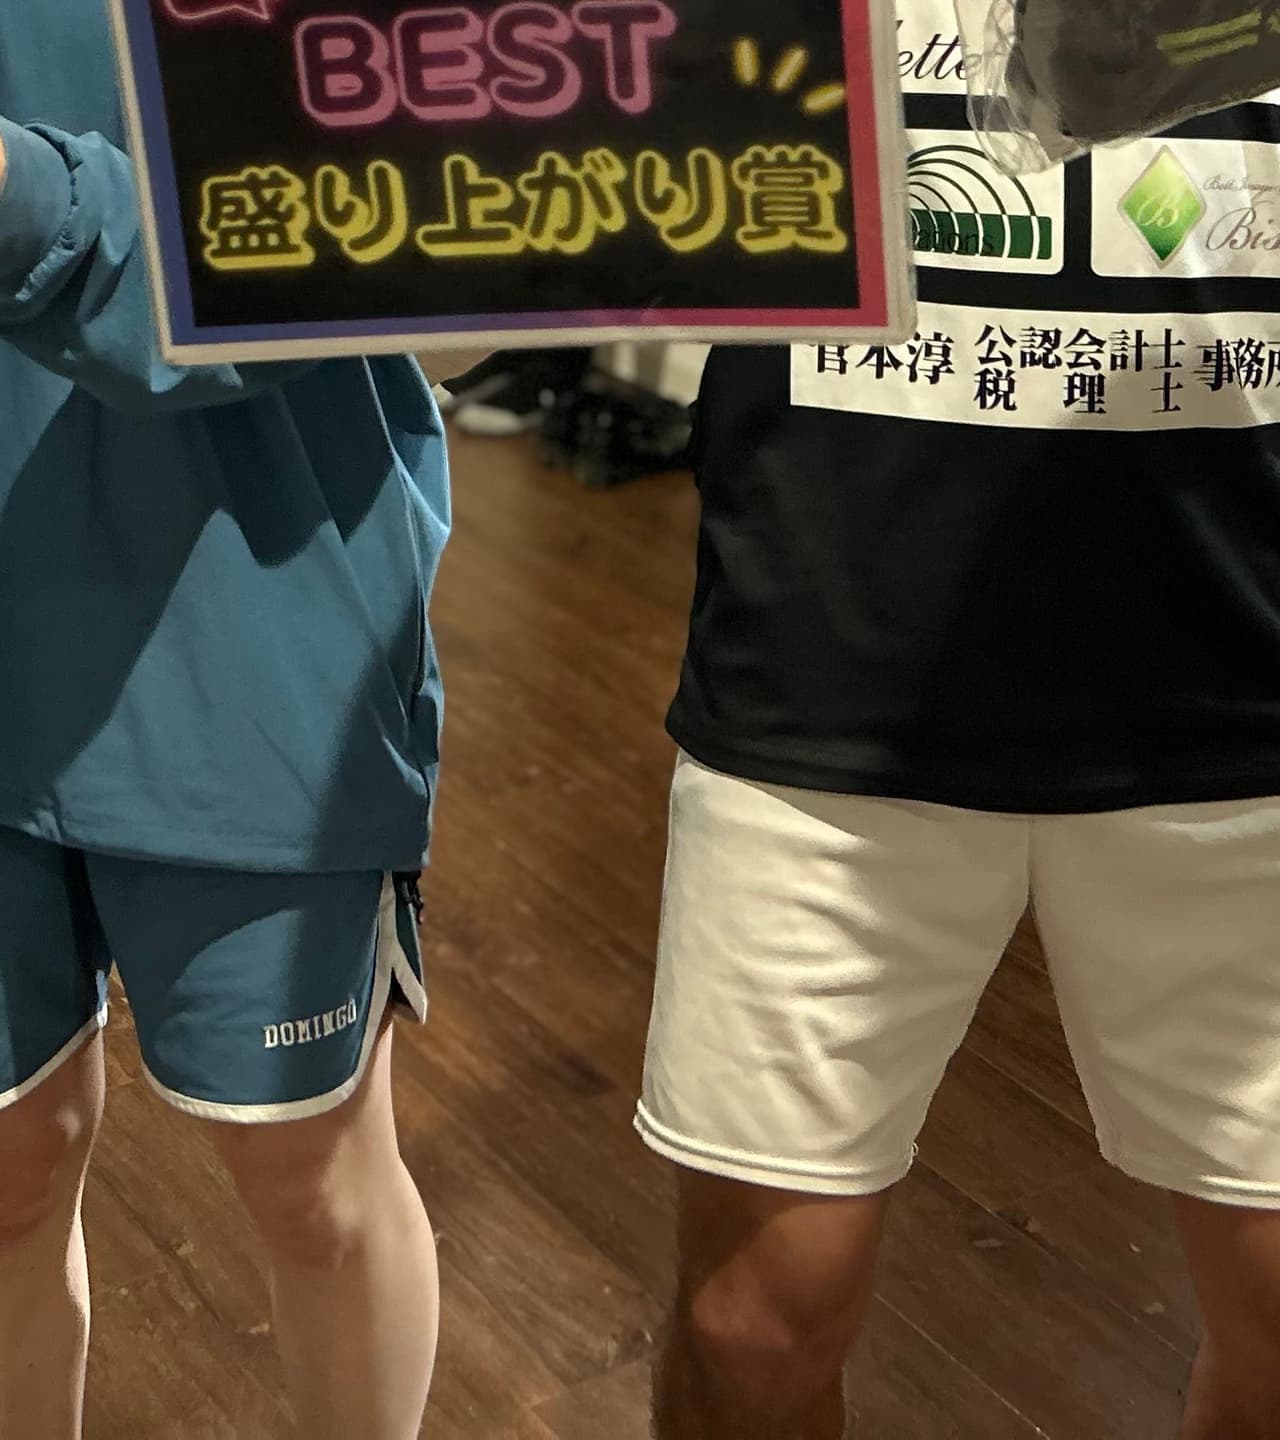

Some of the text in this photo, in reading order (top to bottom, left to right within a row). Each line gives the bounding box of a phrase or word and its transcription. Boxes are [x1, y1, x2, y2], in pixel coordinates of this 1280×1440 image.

[200, 143, 849, 270] 盛り上がり賞
[974, 324, 1186, 372] 公認会計士
[263, 998, 357, 1049] DOMINGO
